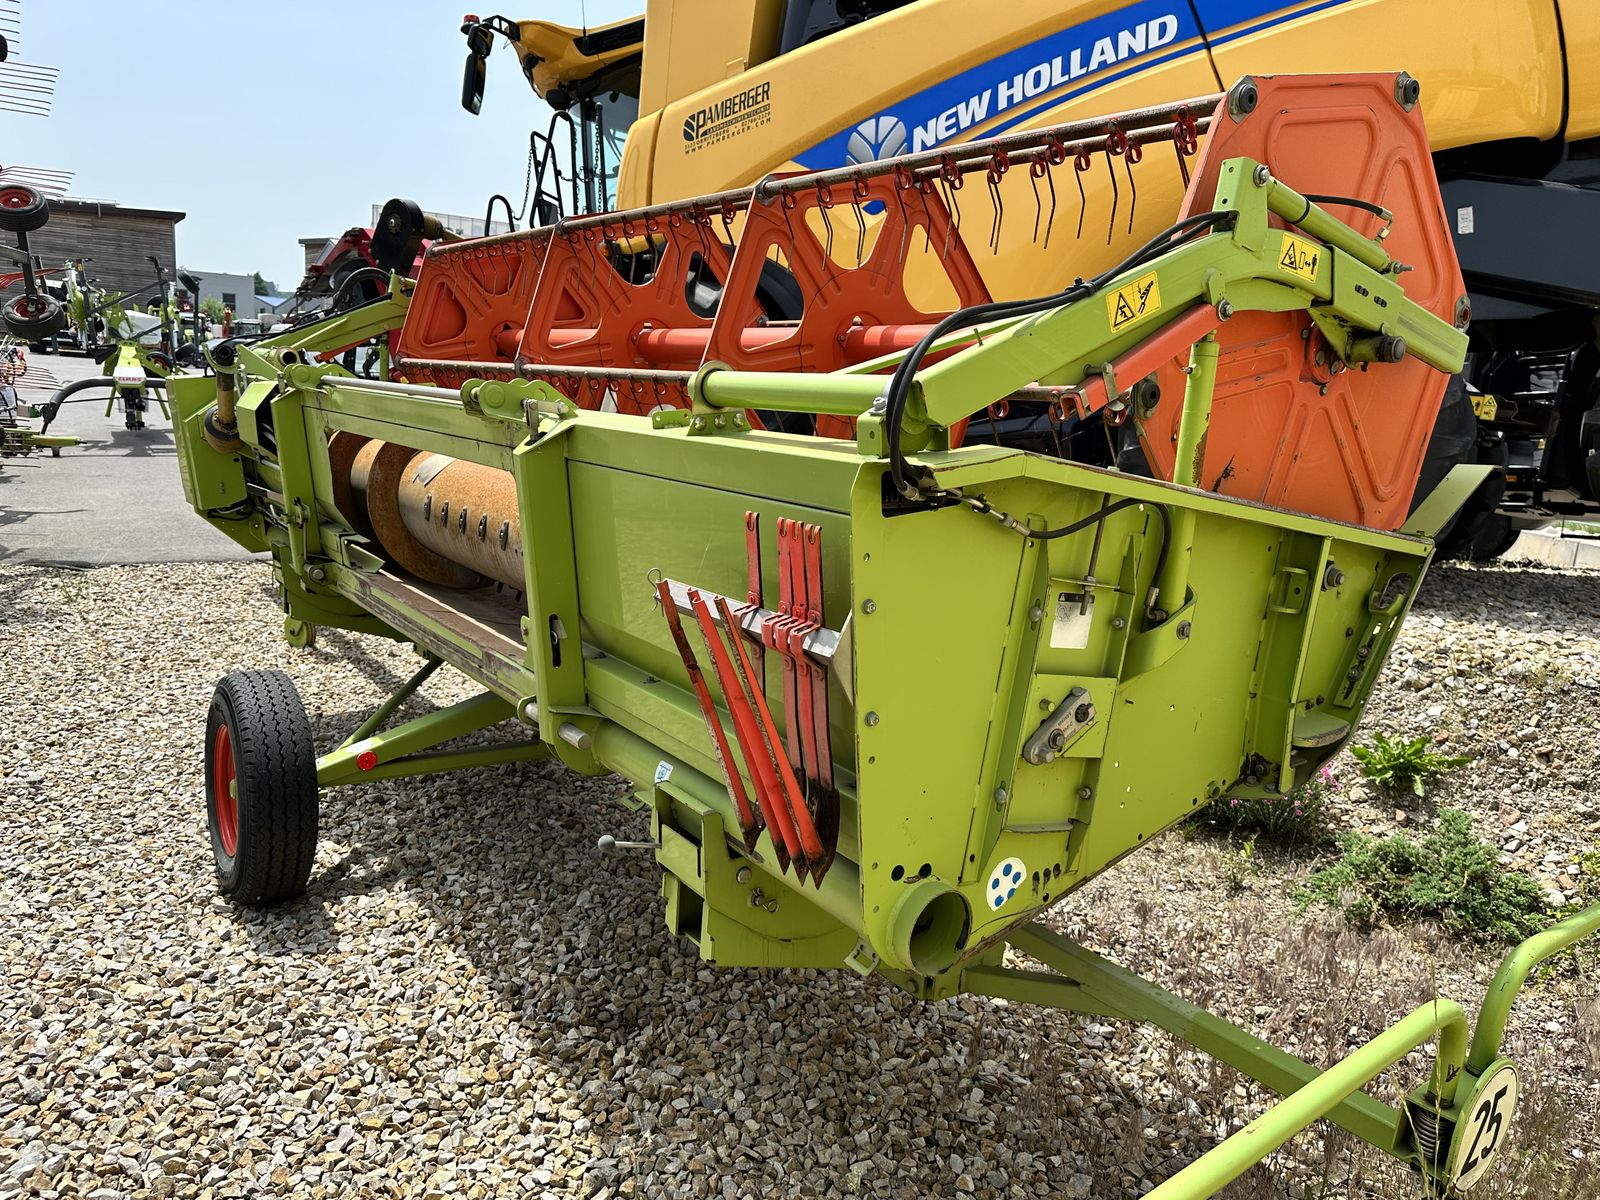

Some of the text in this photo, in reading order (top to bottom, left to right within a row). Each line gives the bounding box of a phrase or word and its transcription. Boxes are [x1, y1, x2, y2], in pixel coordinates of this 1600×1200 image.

[695, 81, 770, 140] PAMBERGER
[912, 13, 1178, 153] NEW HOLLAND
[684, 117, 771, 155] WWW.PAMBERGER.COM
[1459, 1085, 1508, 1178] 25
